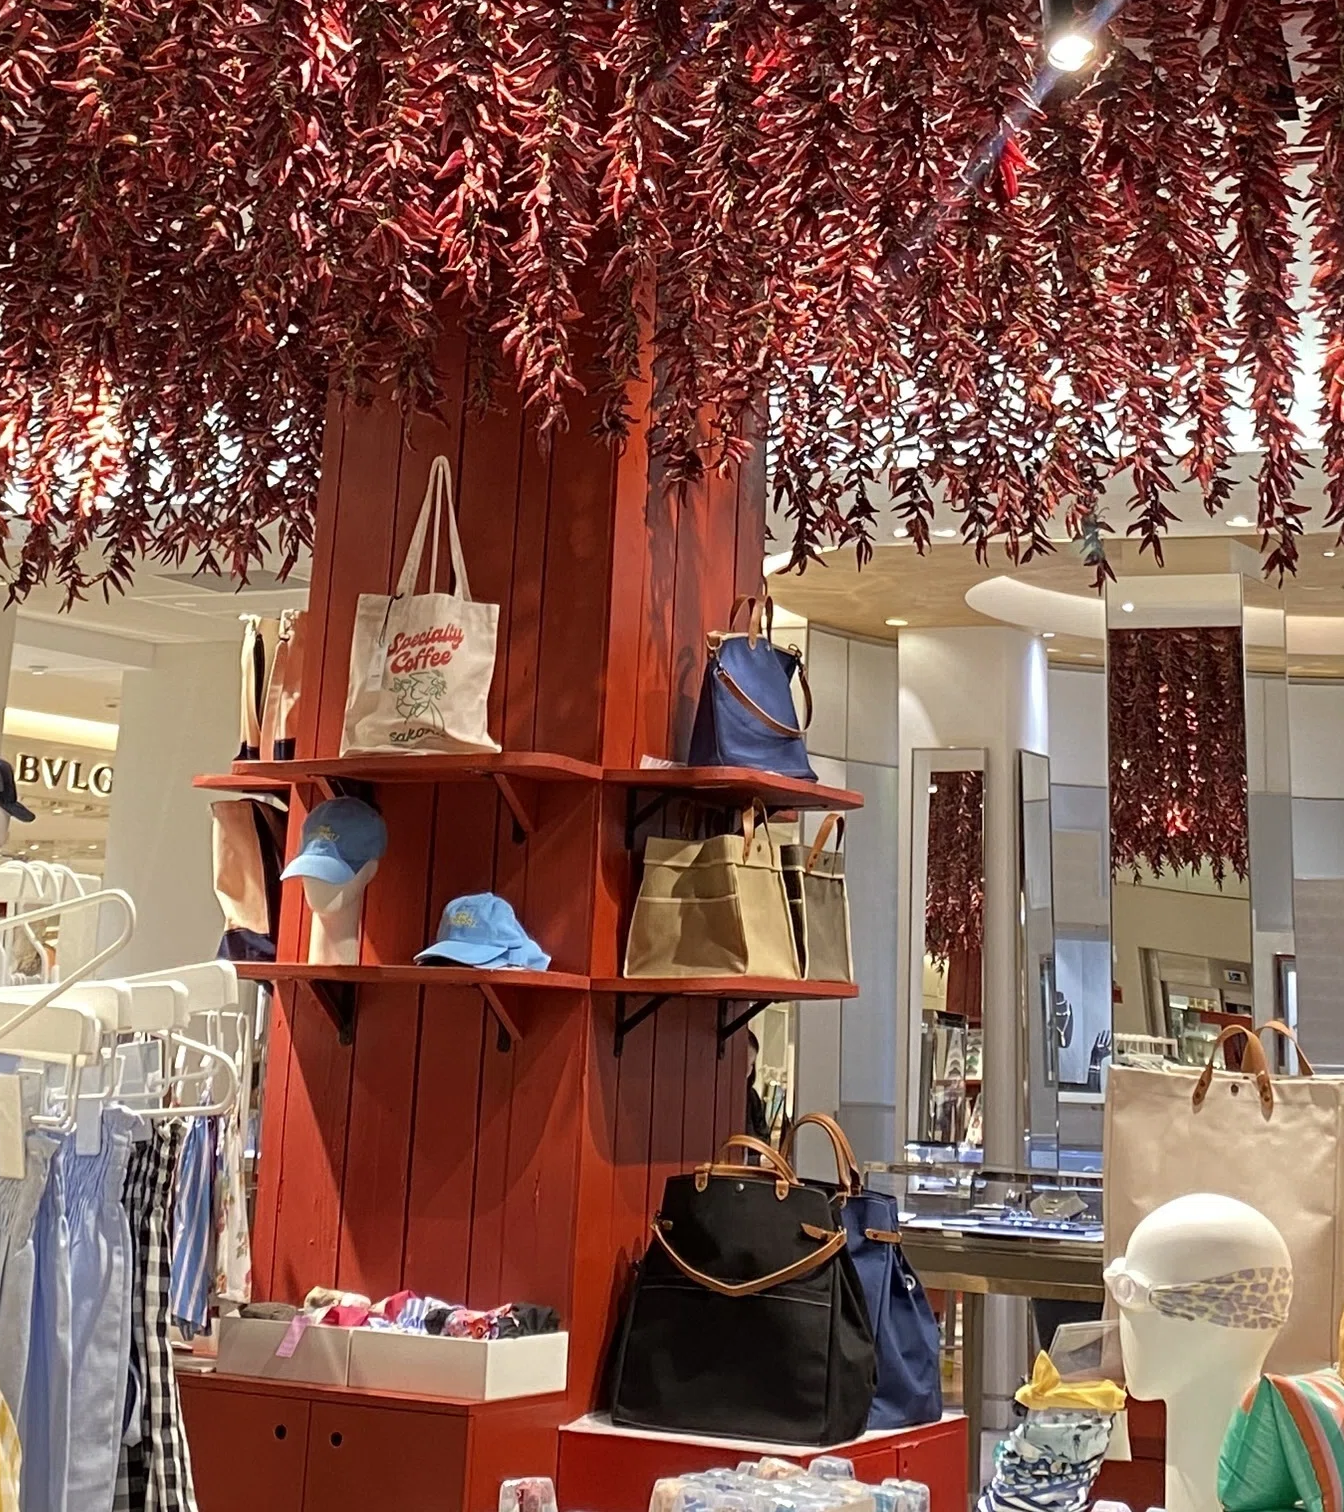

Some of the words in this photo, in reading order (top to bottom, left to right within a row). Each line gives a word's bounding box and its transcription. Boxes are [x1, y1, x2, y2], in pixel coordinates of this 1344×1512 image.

[387, 623, 464, 657] Specialty
[391, 647, 452, 674] Coffee
[17, 754, 114, 795] BVLG
